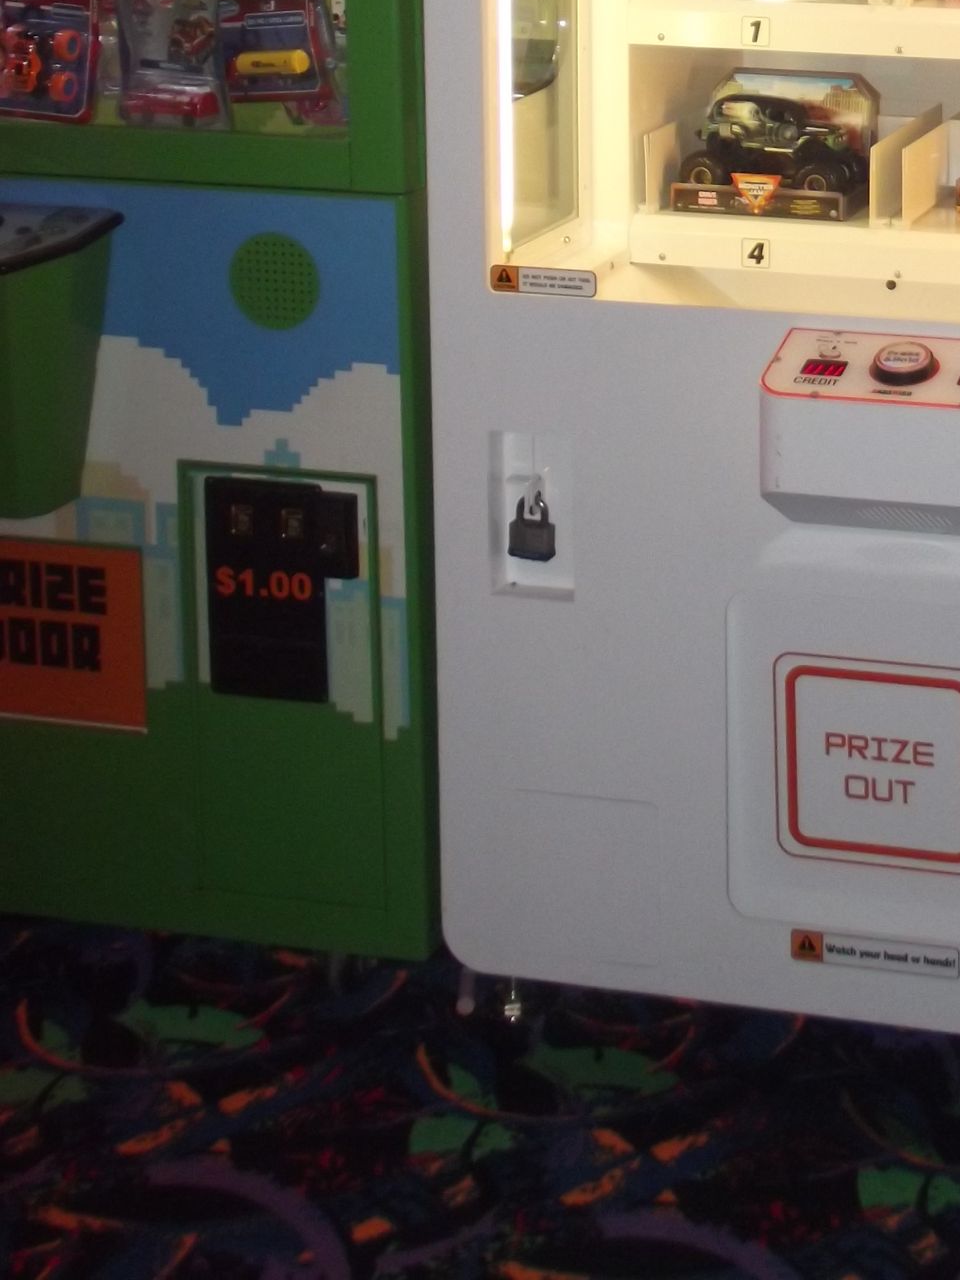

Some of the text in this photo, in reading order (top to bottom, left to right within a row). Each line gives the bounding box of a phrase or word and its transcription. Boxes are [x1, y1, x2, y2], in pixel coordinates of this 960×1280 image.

[750, 20, 762, 43] 1
[747, 242, 765, 265] 4
[793, 376, 840, 386] CREDIT
[215, 565, 313, 601] $1.00
[0, 616, 102, 672] OOR
[825, 731, 935, 768] PRIZE
[844, 775, 916, 804] OUT
[825, 942, 857, 956] Watch
